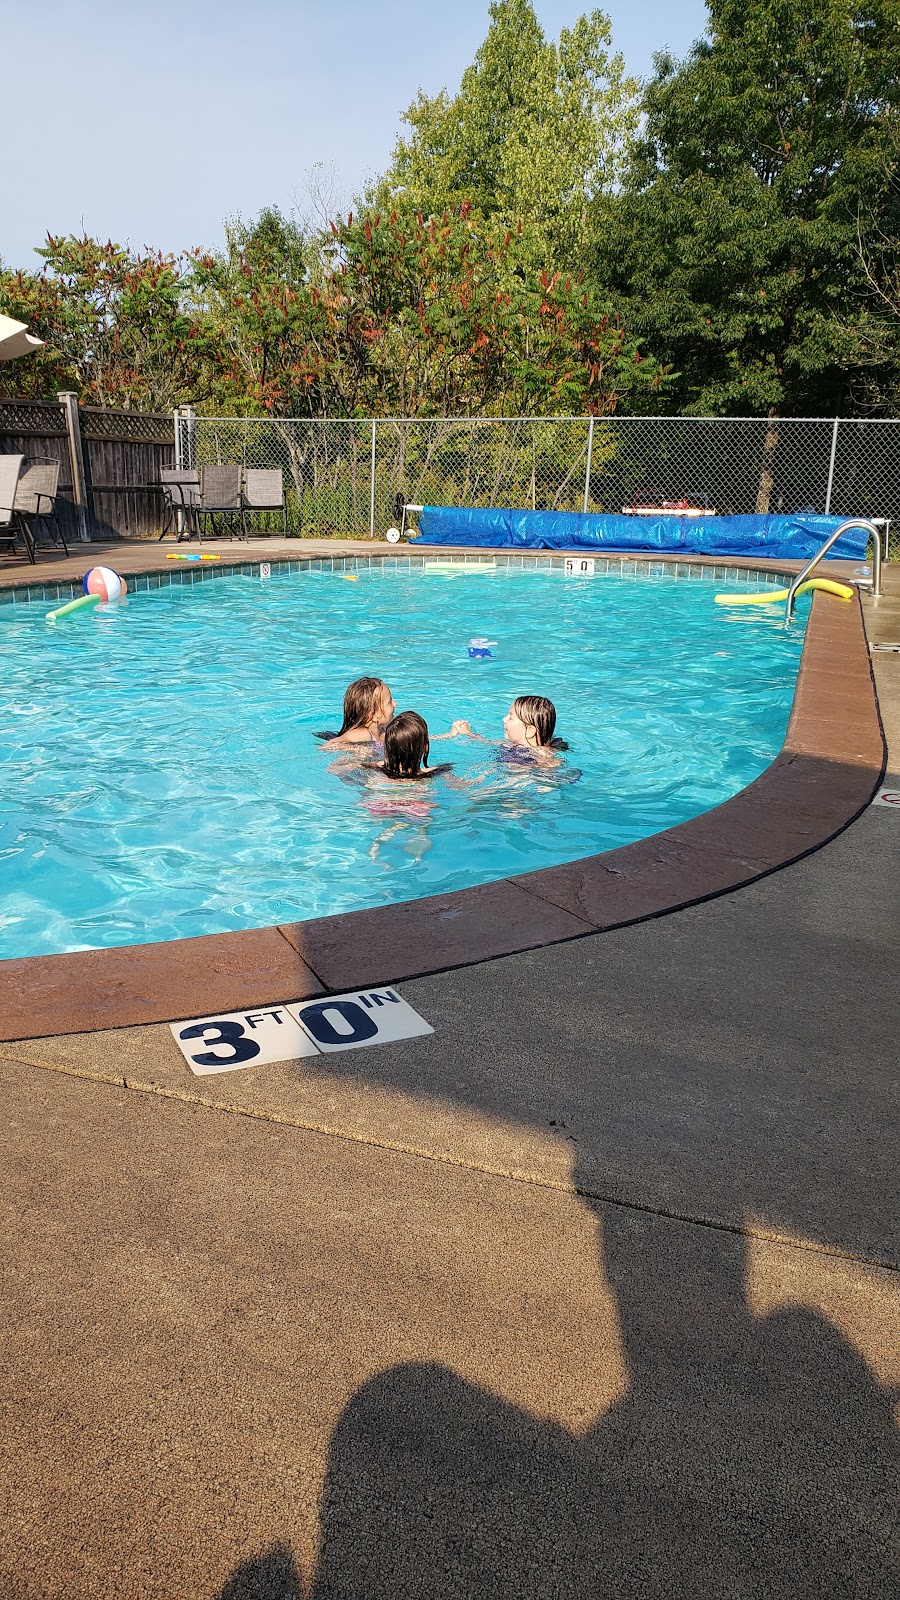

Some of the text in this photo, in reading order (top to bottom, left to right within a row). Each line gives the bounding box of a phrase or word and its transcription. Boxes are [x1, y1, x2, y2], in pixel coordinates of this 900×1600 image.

[566, 560, 573, 571] 5
[580, 560, 588, 571] 0
[179, 990, 401, 1066] 3 FT 0 IN
